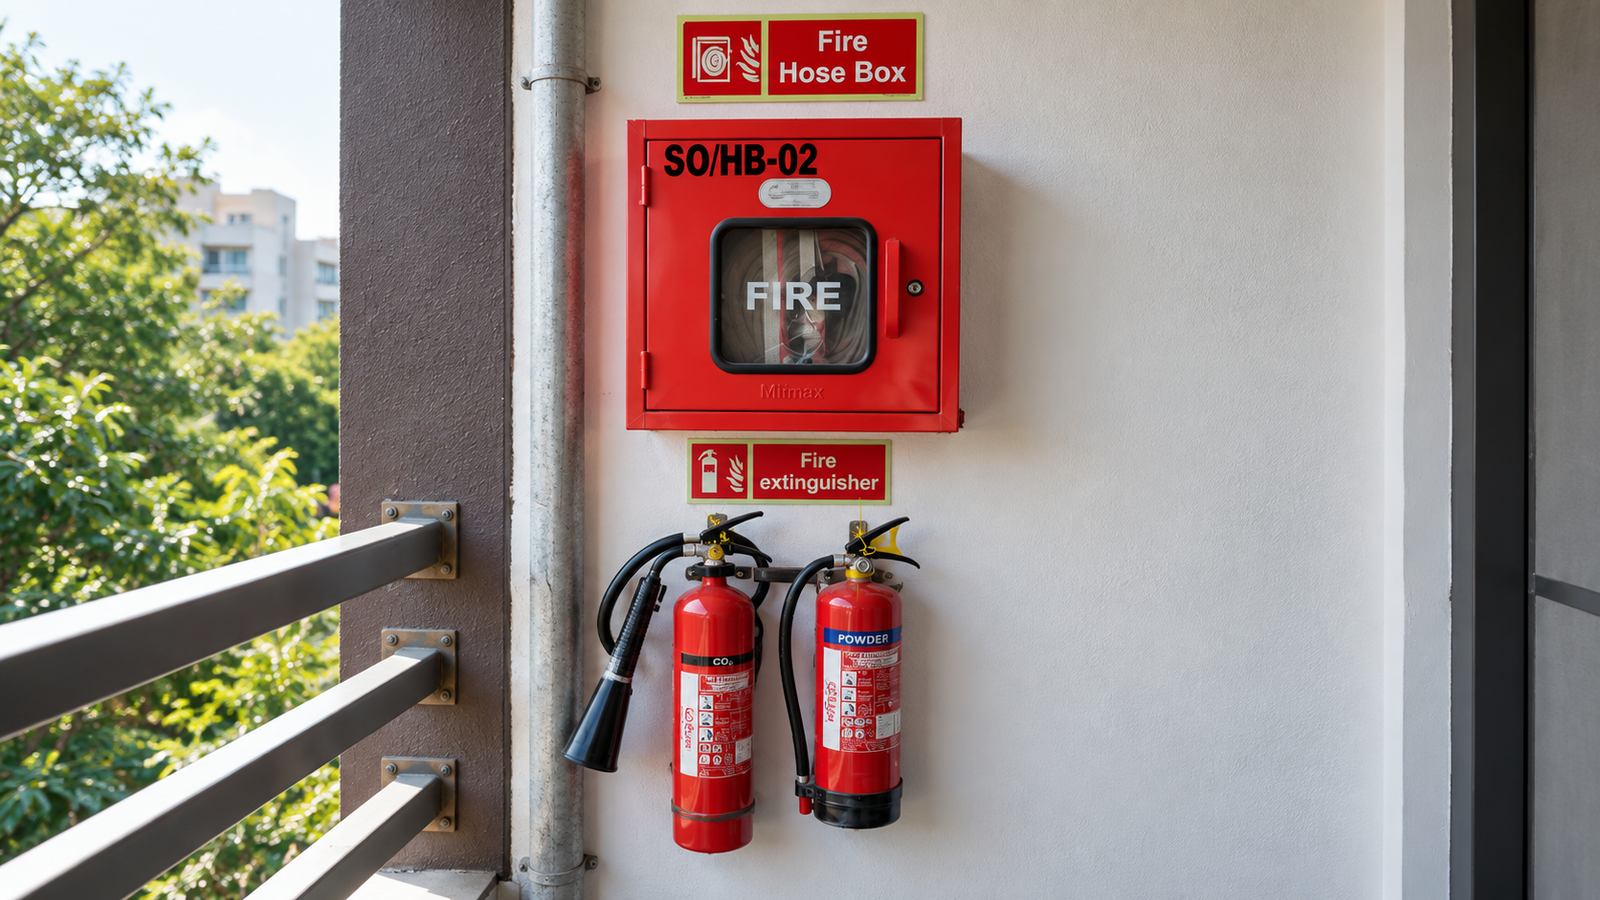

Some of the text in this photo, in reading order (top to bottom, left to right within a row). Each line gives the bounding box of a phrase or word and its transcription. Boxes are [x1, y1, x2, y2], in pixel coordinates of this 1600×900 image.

[818, 29, 868, 52] Fire
[779, 60, 906, 84] Hose Box
[663, 143, 818, 177] SO/HB-02
[746, 281, 841, 311] FIRE
[800, 452, 837, 468] Fire
[759, 474, 879, 494] extinguisher
[838, 633, 889, 645] POWDER
